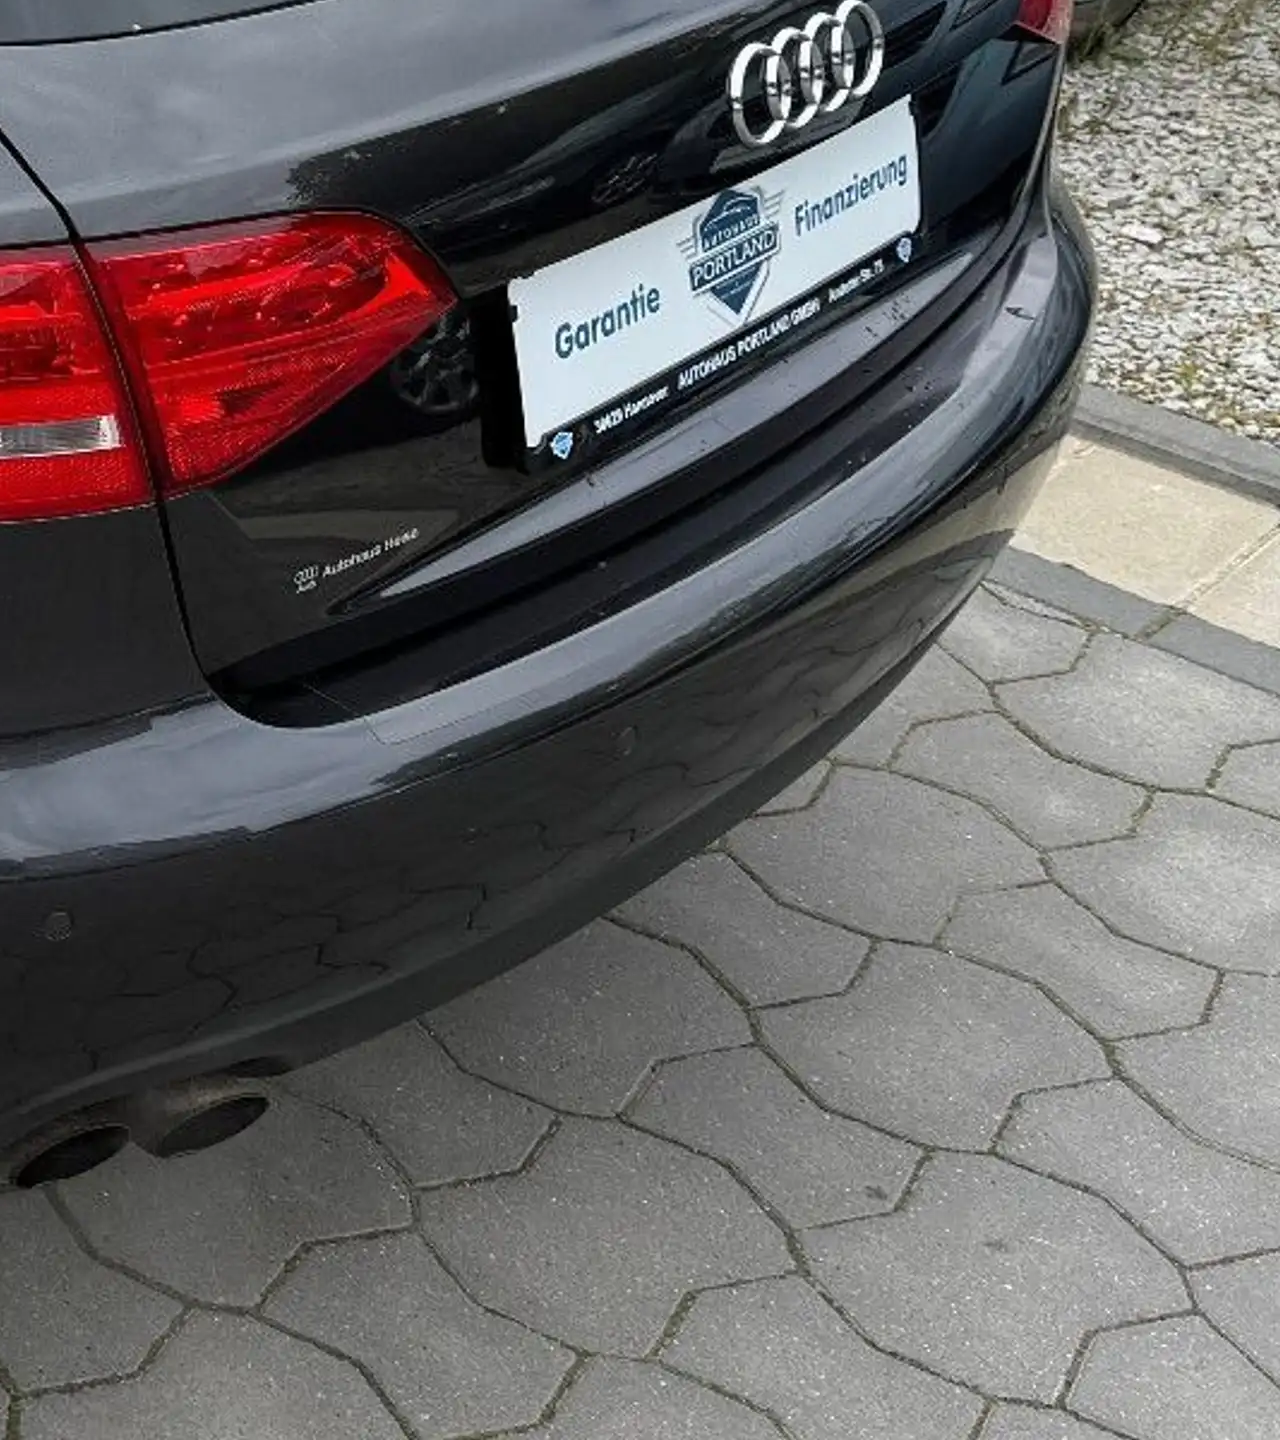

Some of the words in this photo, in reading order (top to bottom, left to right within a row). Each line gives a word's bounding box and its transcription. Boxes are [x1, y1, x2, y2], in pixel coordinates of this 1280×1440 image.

[794, 155, 908, 237] Finanzierung
[693, 229, 775, 288] PORTLAND
[555, 283, 660, 359] Garantie
[677, 344, 737, 390] AUTOHAUS
[737, 314, 790, 358] PORTLAND
